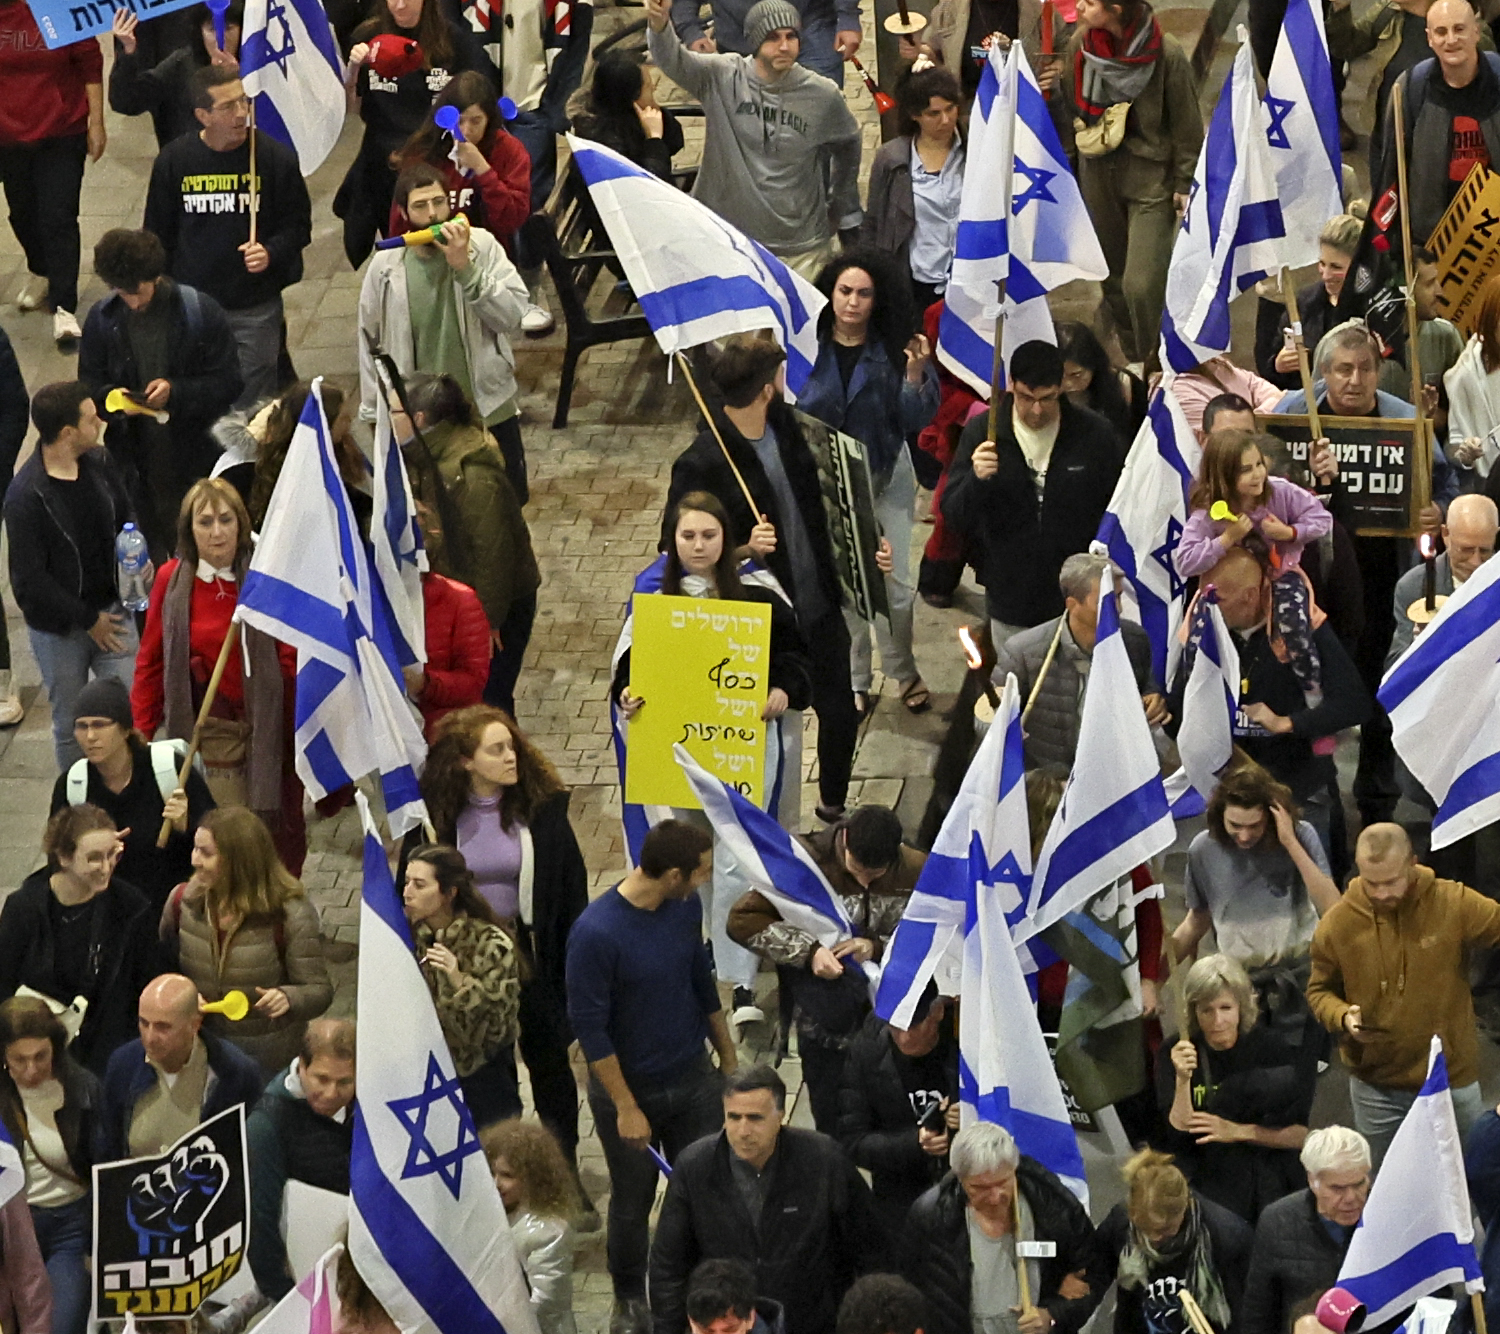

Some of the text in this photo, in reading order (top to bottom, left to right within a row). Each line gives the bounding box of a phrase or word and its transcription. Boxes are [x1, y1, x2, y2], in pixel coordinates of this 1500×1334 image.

[182, 193, 237, 213] אקדמיה
[1368, 471, 1405, 495] עם
[670, 607, 763, 635] ירושלים
[728, 639, 761, 663] של
[716, 690, 758, 718] ושל
[713, 747, 756, 773] ושל
[103, 1222, 243, 1291] חובה
